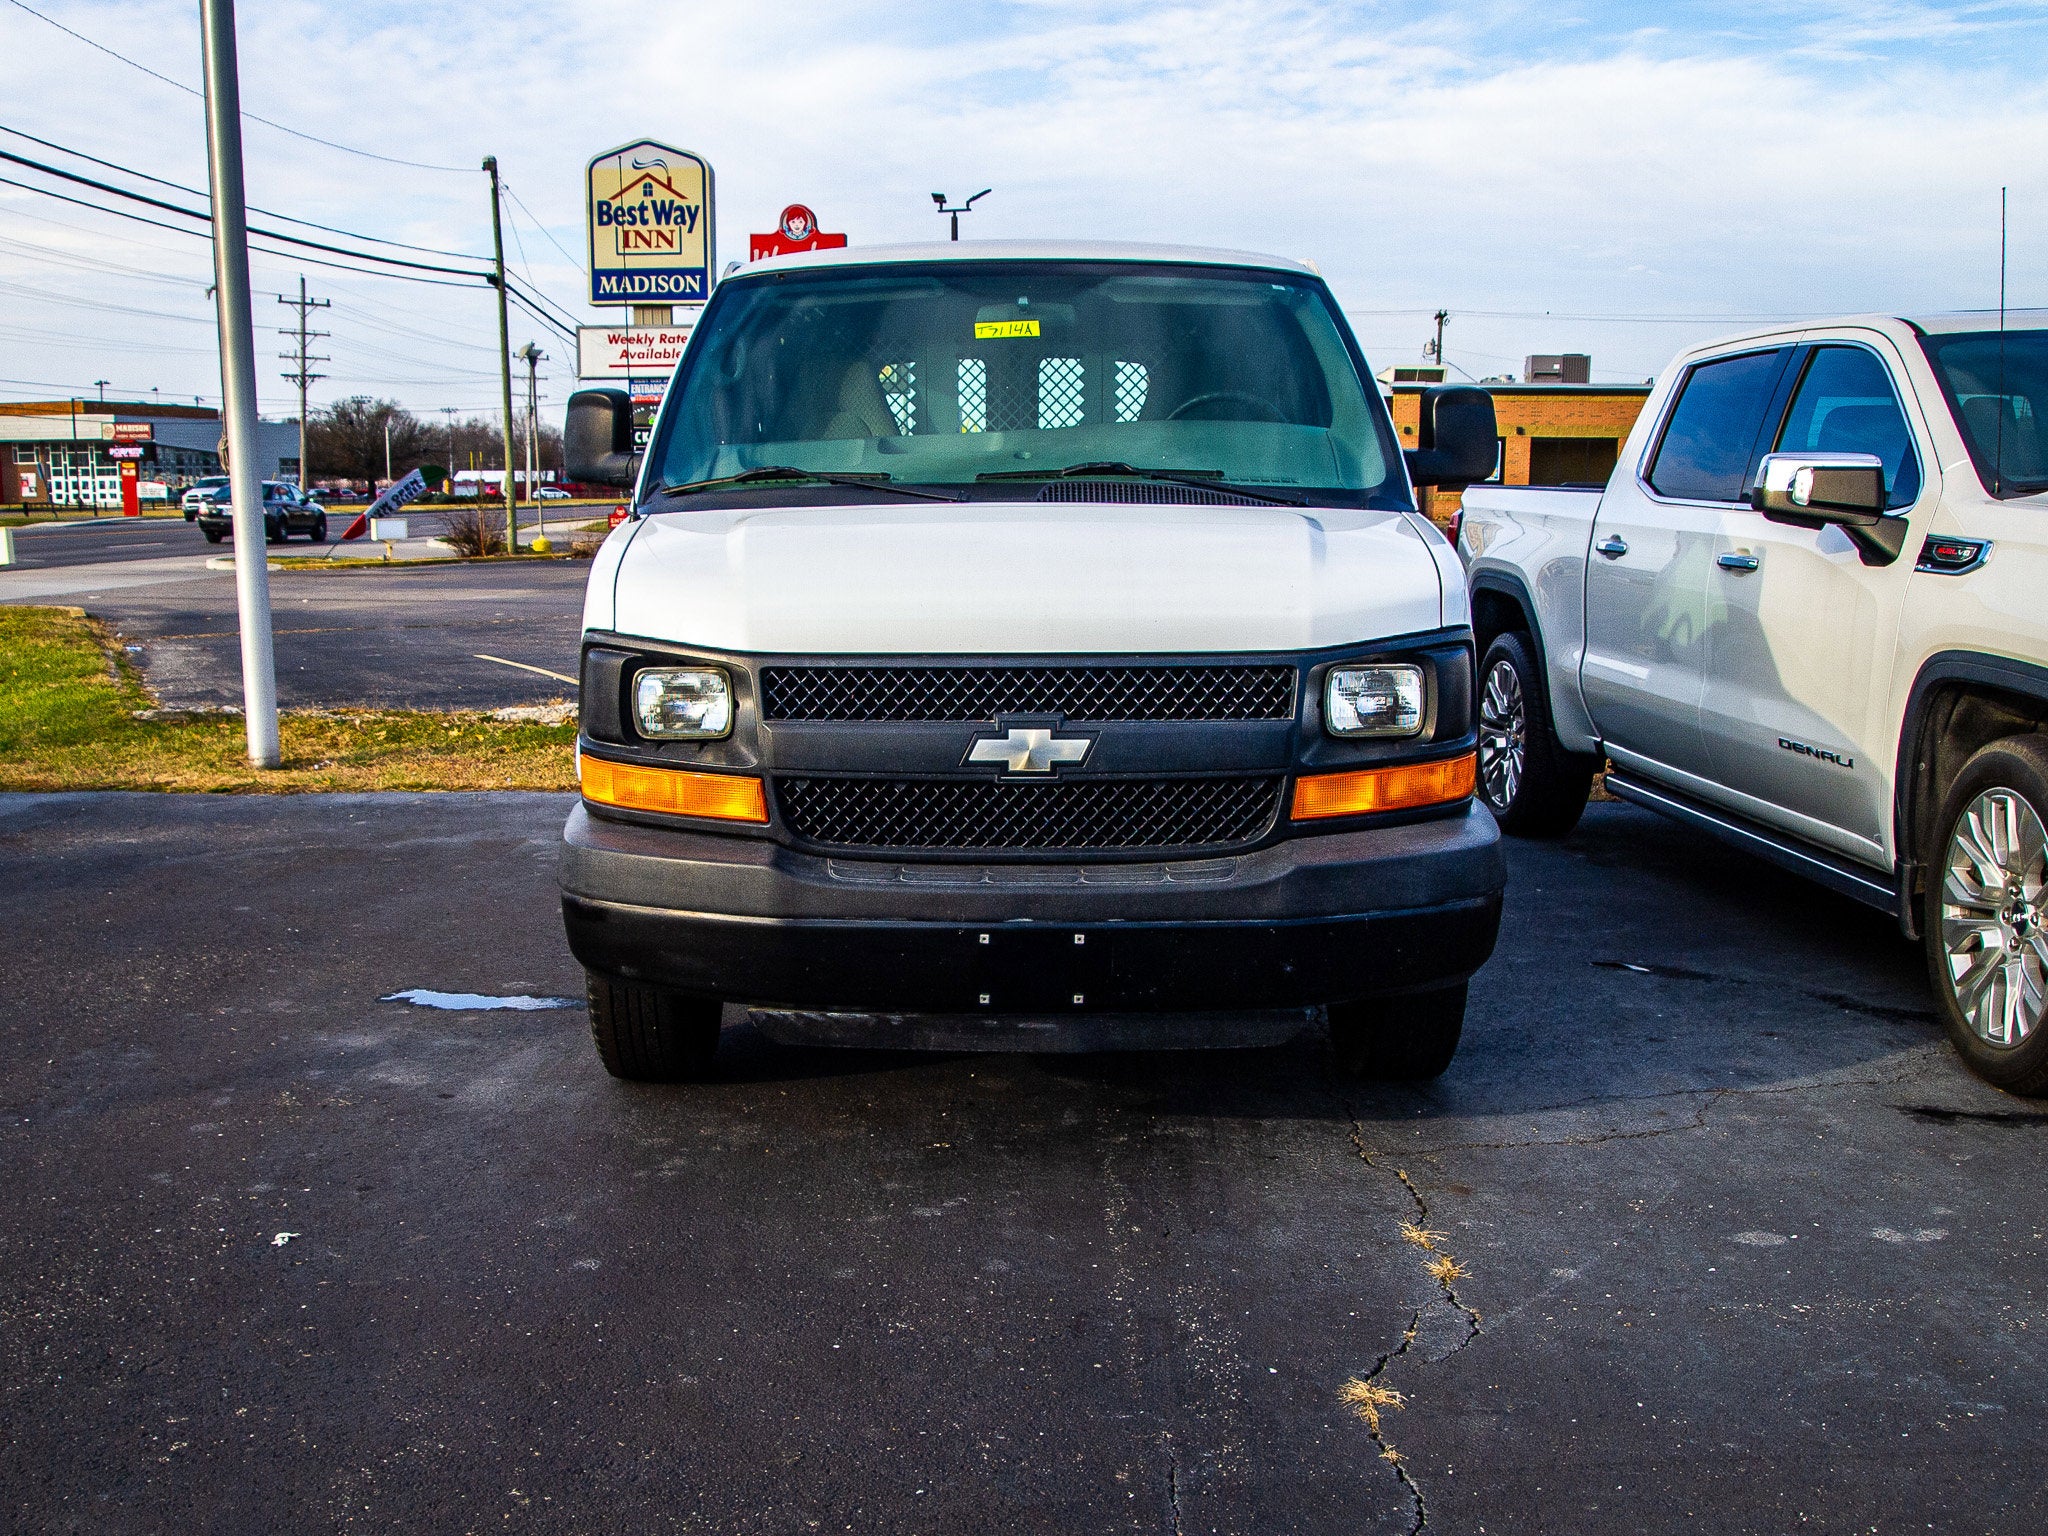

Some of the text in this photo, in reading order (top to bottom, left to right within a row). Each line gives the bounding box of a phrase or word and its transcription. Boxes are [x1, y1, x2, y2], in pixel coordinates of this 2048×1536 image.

[597, 199, 700, 234] Best Way
[623, 229, 676, 249] INN
[599, 275, 701, 294] MADISON
[608, 333, 688, 347] Weekly Rate
[619, 348, 682, 360] Available
[631, 384, 668, 394] ENTRANC
[115, 424, 149, 432] MADISON
[391, 479, 418, 502] OPEN
[1778, 737, 1854, 770] DENALI
